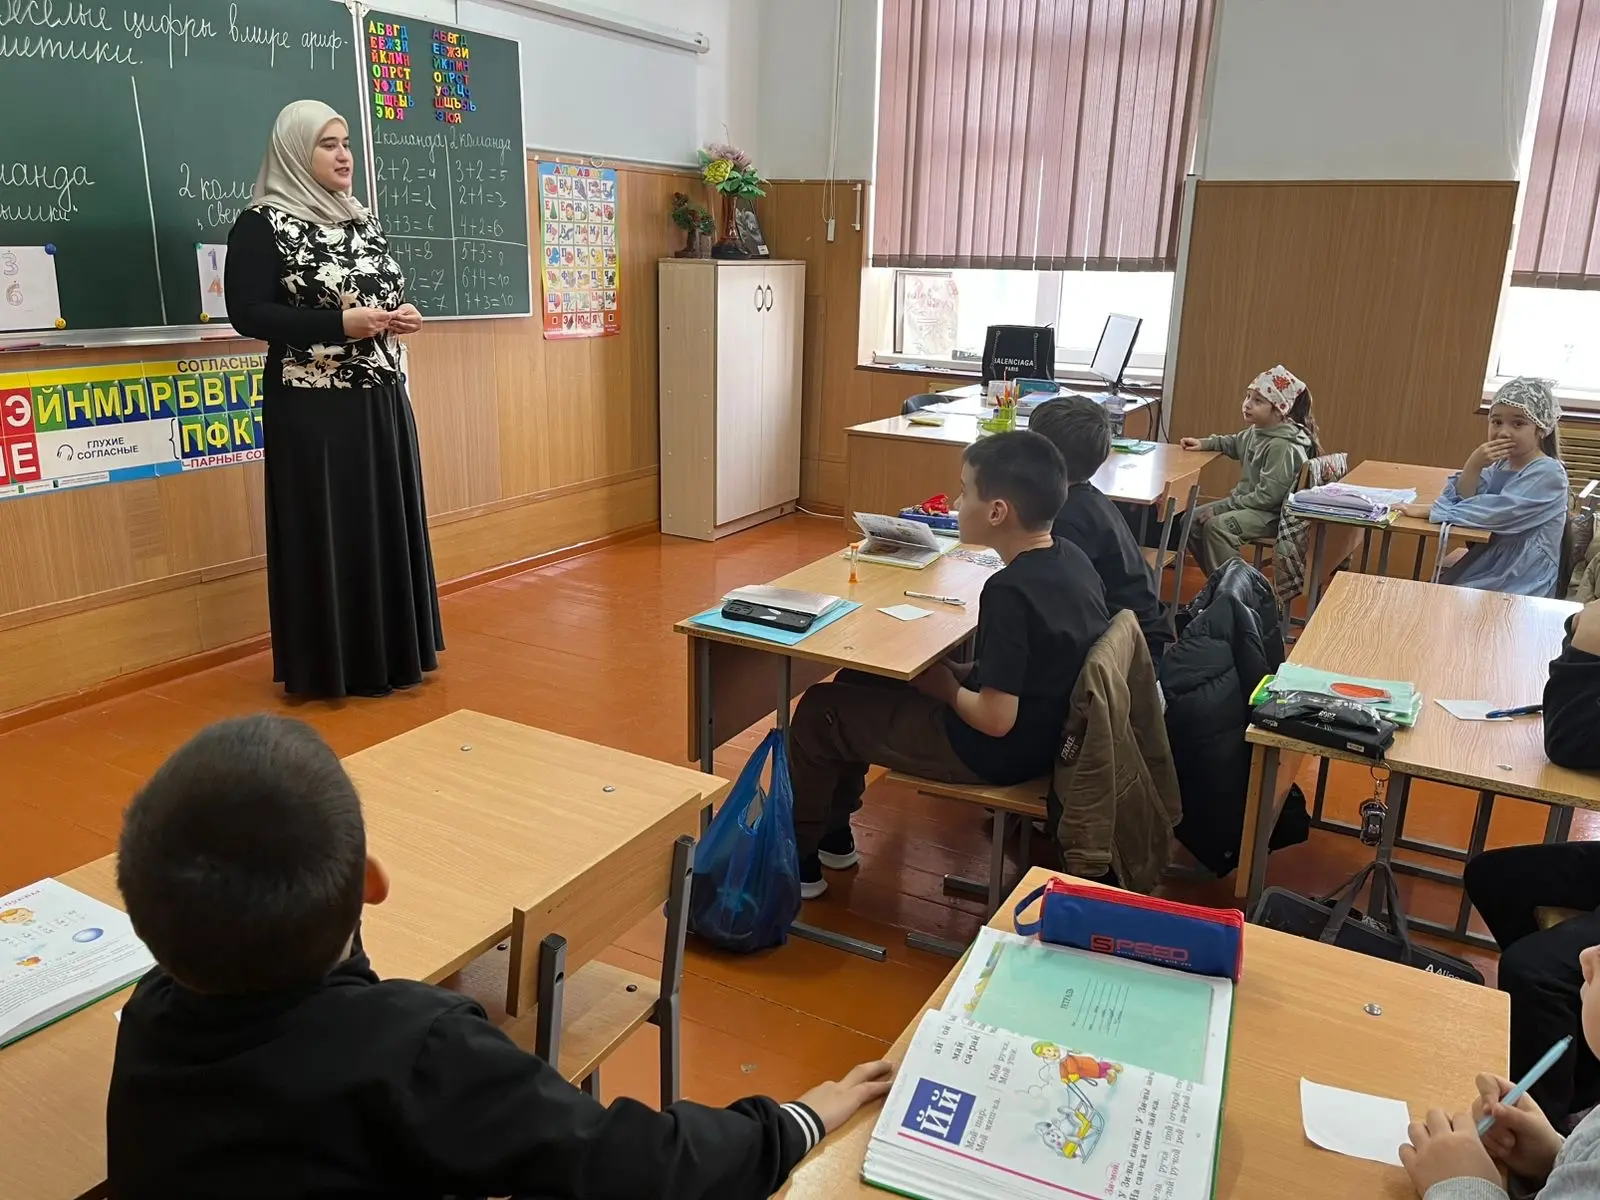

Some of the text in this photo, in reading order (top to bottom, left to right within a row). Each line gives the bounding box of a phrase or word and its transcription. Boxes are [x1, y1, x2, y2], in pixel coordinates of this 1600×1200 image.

[123, 3, 217, 69] цифры
[179, 163, 196, 198] 2
[177, 355, 266, 373] СОГЛАСНЫ
[77, 445, 139, 460] СОГЛАСНЫЕ
[87, 437, 125, 448] ГЛУХИЕ
[1091, 934, 1189, 961] SPEED
[916, 1088, 962, 1138] Йй
